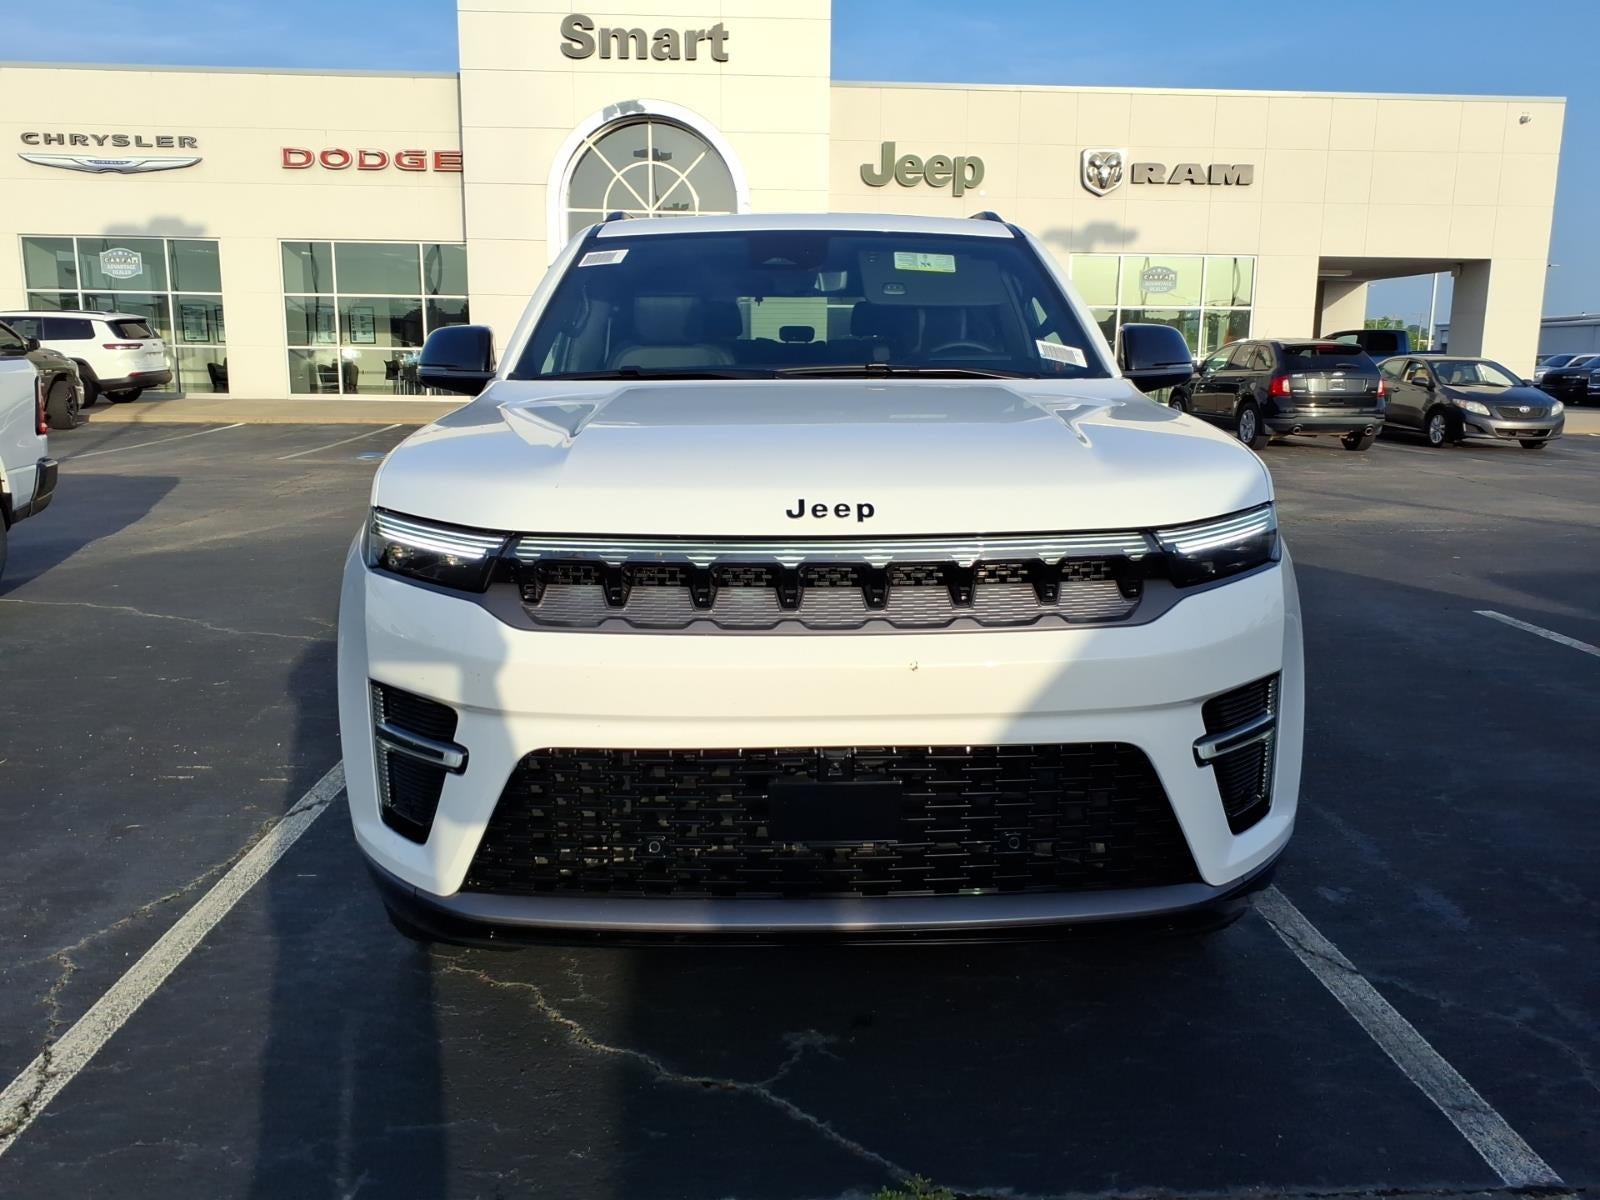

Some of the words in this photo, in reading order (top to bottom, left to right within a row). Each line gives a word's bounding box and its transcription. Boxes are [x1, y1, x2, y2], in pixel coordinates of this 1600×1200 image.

[560, 13, 729, 62] Smart
[20, 132, 198, 149] CHRYSLER
[281, 147, 463, 172] DODGE
[860, 141, 985, 198] Jeep
[1130, 163, 1254, 185] RAM
[786, 499, 875, 522] Jeep
